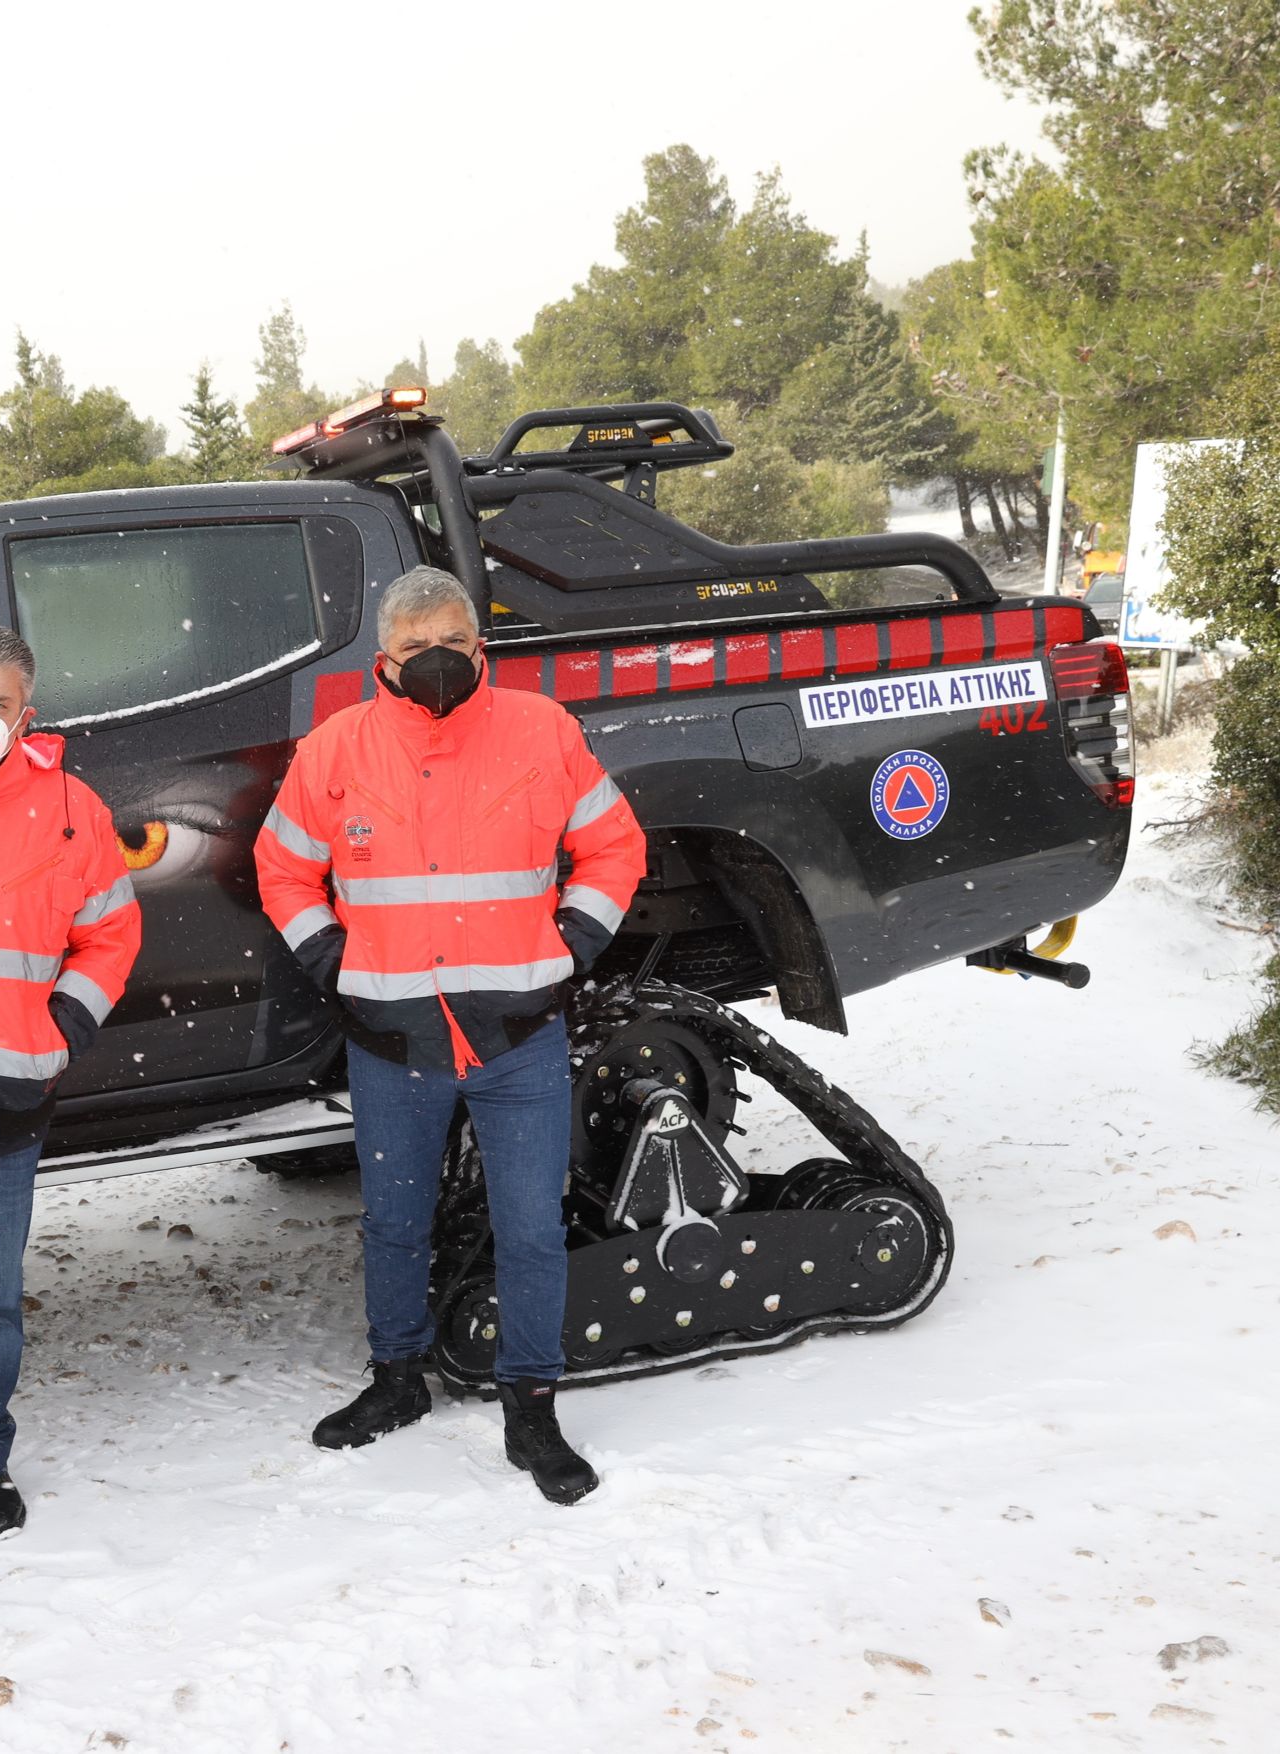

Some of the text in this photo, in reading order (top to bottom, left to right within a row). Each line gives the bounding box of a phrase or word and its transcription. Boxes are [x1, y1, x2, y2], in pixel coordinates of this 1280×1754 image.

[808, 668, 1036, 721] ΠΕΡΙΦΕΡΕΙΑ ΑΤΤΙΚΗΣ
[978, 700, 1049, 737] 402
[874, 754, 945, 812] ΠΟΛΙΤΙΚΗ ΠΡΟΣΤΑΣΙΑ
[889, 818, 934, 836] ΕΛΛΑΔΑ
[659, 1112, 686, 1129] ACF
